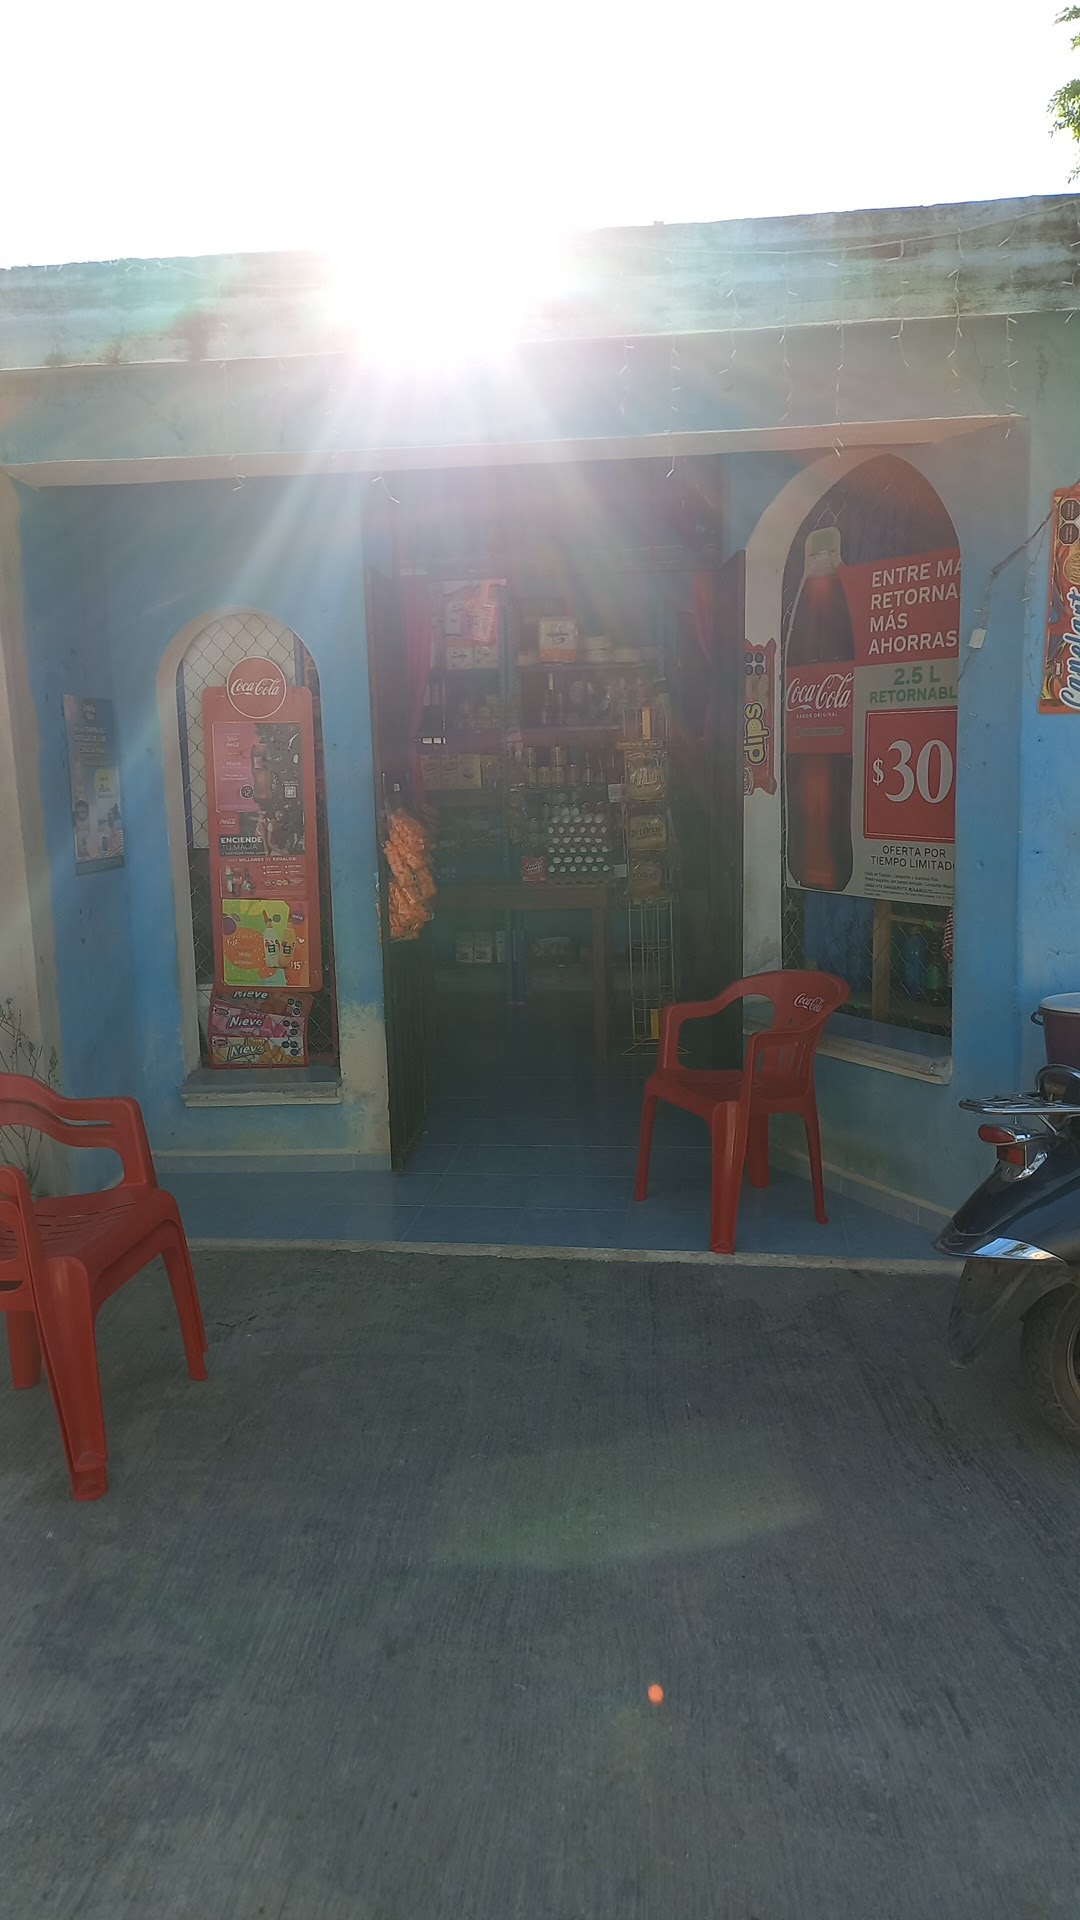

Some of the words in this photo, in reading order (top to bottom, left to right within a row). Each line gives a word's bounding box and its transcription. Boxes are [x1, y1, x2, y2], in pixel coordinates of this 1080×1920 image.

[871, 562, 931, 588] ENTRE
[869, 609, 908, 633] MÁS
[868, 630, 957, 655] AHORRAS
[893, 666, 923, 685] 2.5
[929, 665, 941, 683] L
[231, 677, 283, 696] Coca-Cola
[786, 672, 854, 712] Coca-Cola
[869, 686, 957, 704] RETORNABL
[220, 836, 263, 844] ENCIENDE
[871, 856, 907, 867] TIEMPO
[882, 845, 921, 856] OFERTA
[924, 848, 946, 858] POR
[793, 992, 825, 1012] Coca-Cola
